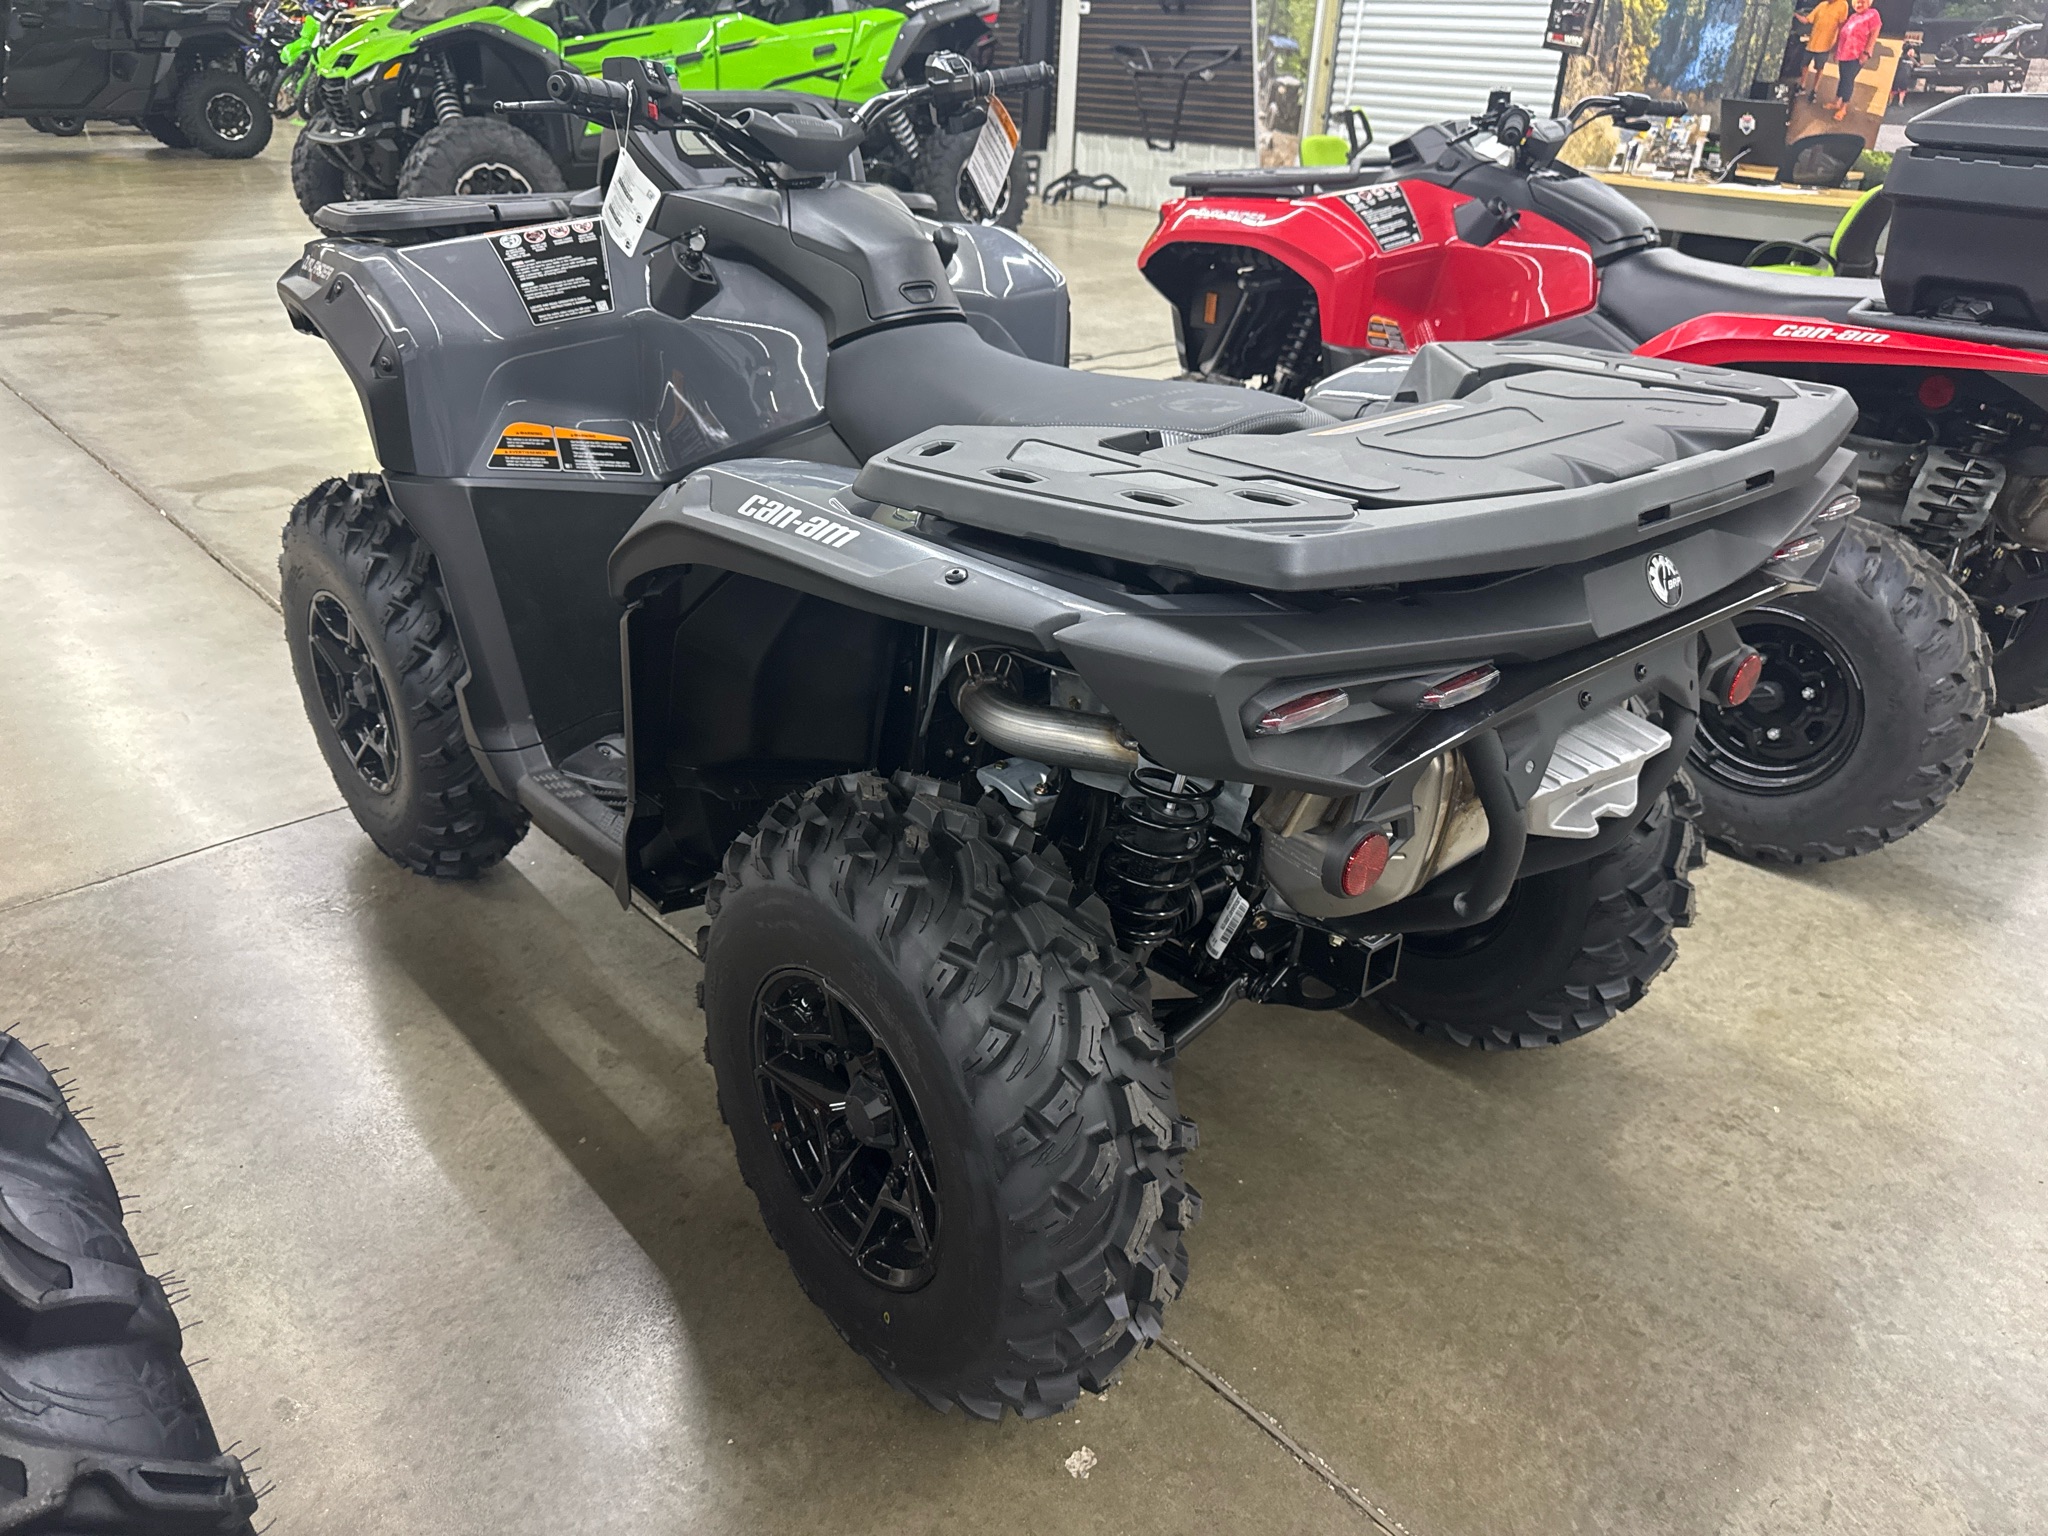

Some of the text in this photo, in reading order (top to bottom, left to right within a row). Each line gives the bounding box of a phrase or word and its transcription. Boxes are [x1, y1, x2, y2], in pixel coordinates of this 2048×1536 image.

[1772, 324, 1891, 343] can-am
[737, 494, 861, 549] can-am
[1667, 576, 1681, 590] BRP
